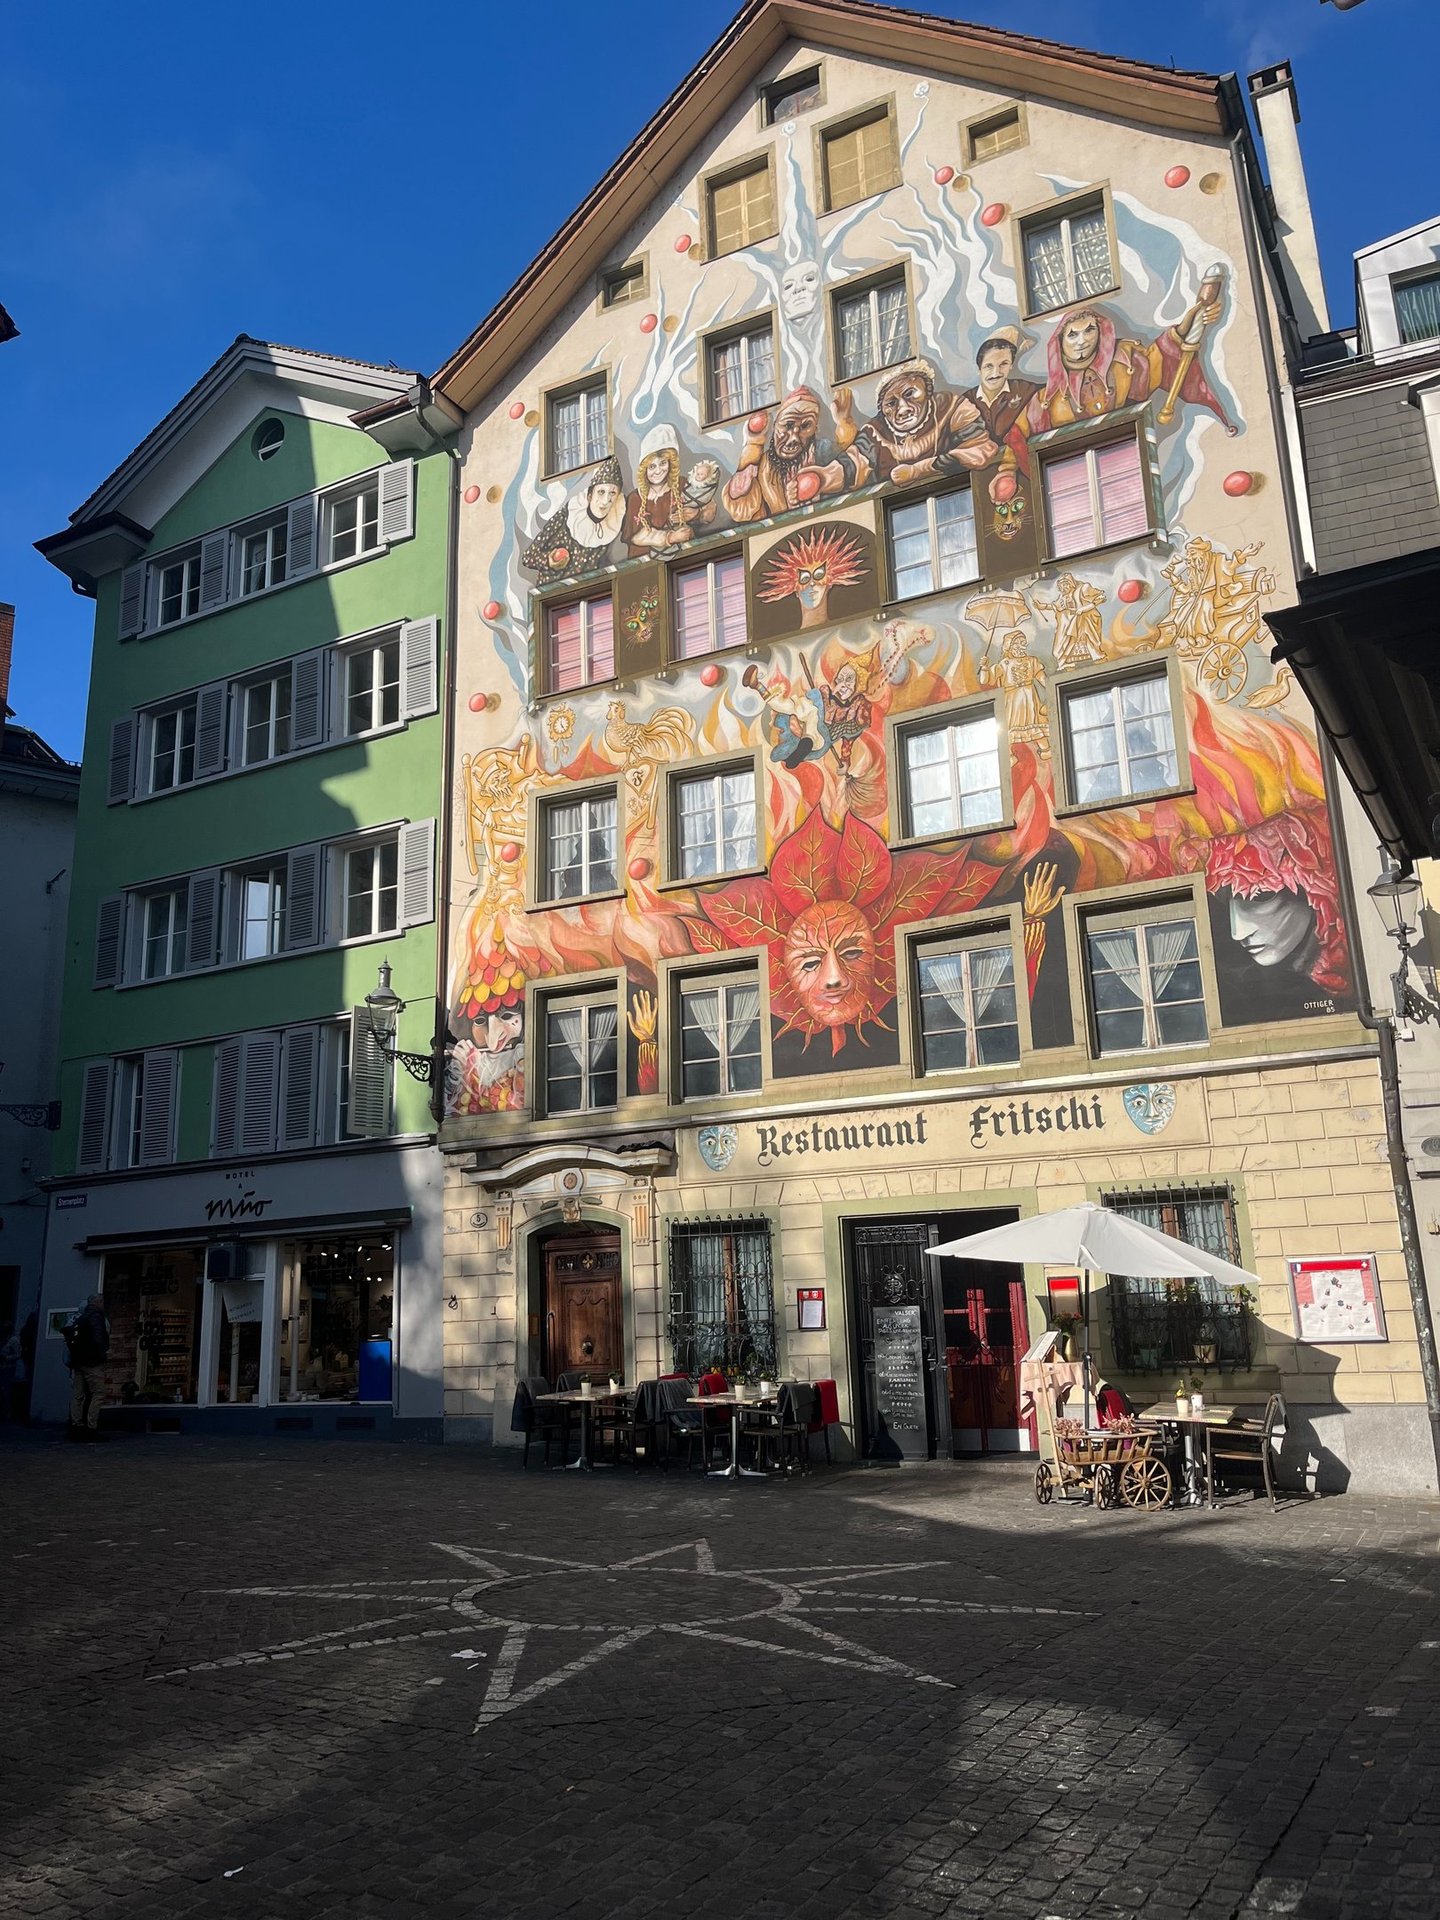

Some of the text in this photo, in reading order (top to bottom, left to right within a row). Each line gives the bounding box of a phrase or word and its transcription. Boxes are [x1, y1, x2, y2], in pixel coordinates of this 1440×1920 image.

[1304, 1000, 1334, 1009] OTTIGER
[757, 1094, 1107, 1167] Restaurant Fritschi
[476, 1214, 481, 1222] 5
